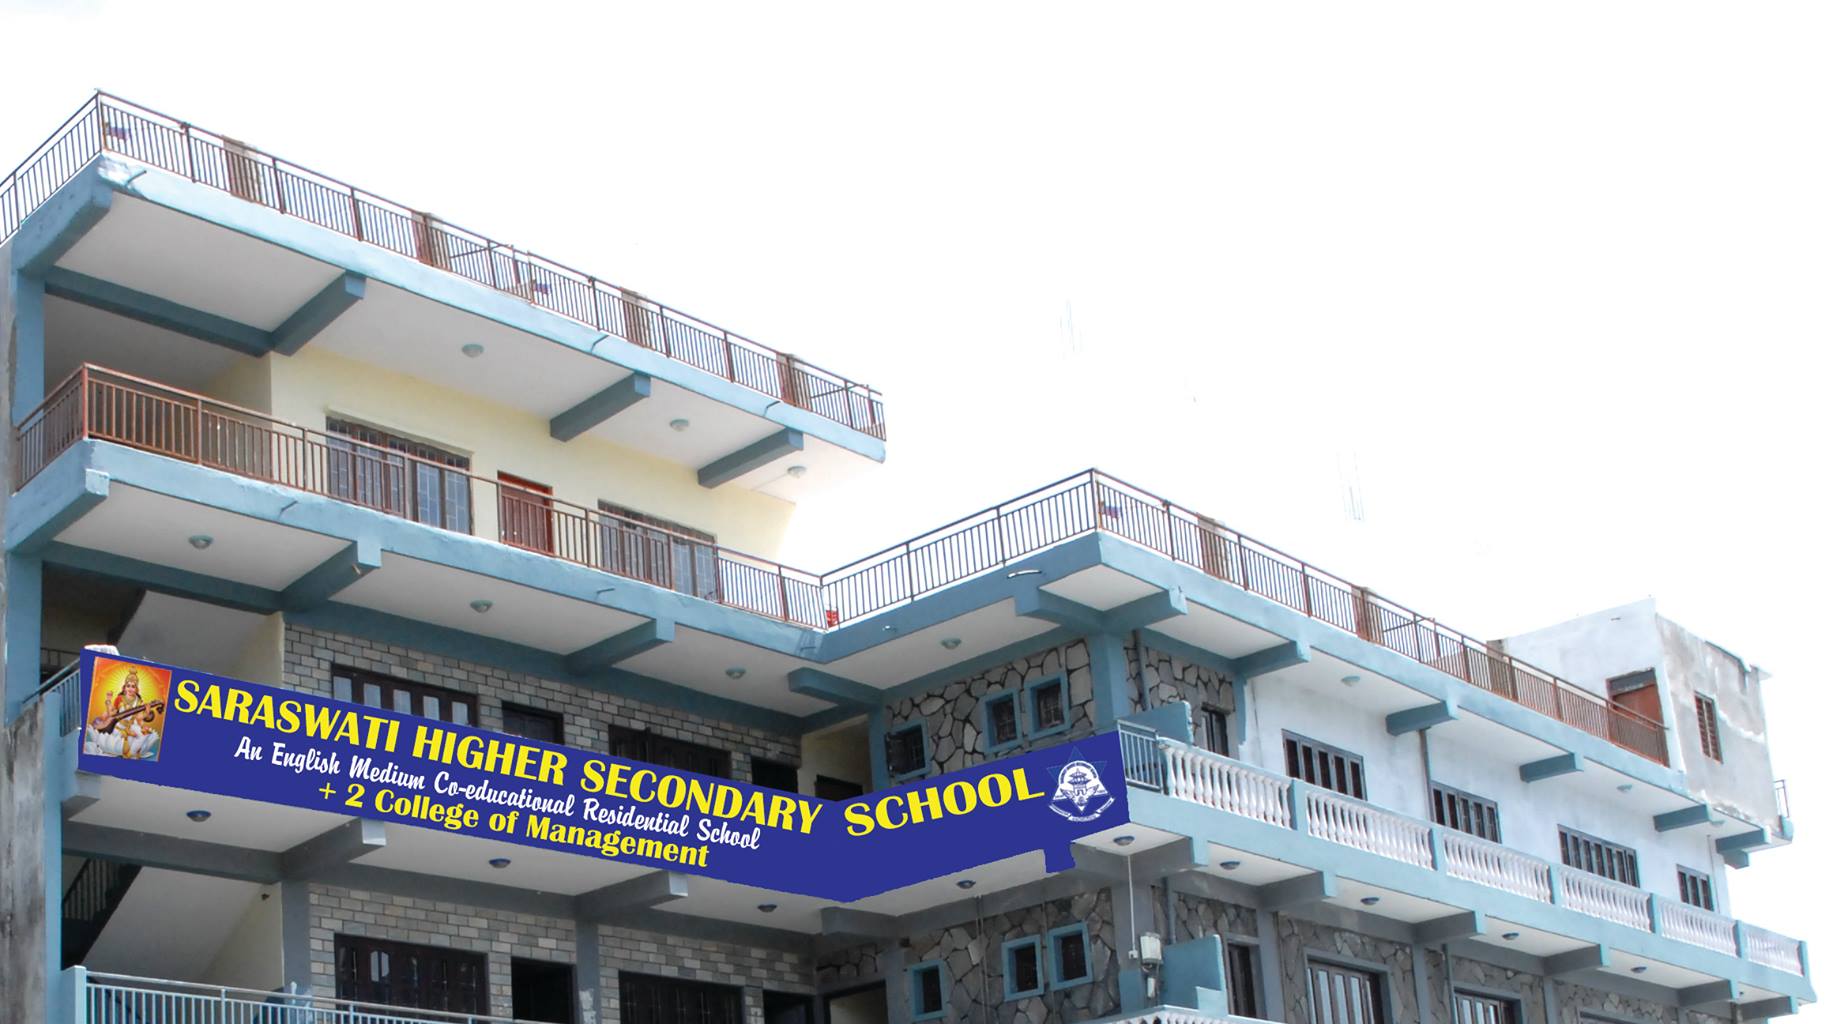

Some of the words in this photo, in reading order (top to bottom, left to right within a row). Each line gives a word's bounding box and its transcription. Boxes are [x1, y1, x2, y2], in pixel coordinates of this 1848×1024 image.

[174, 679, 400, 753] SARASWATI
[412, 725, 568, 785] HIGHER
[580, 759, 823, 834] SECONDARY
[844, 767, 1045, 837] SCHOOL
[233, 735, 263, 761] An
[271, 741, 341, 774] English
[348, 755, 426, 790] Medium
[433, 770, 575, 817] Co-educational
[583, 797, 690, 837] Residential
[696, 818, 761, 850] School
[345, 783, 366, 808] 2
[374, 789, 479, 830] College
[488, 810, 520, 834] of
[526, 814, 708, 868] Management
